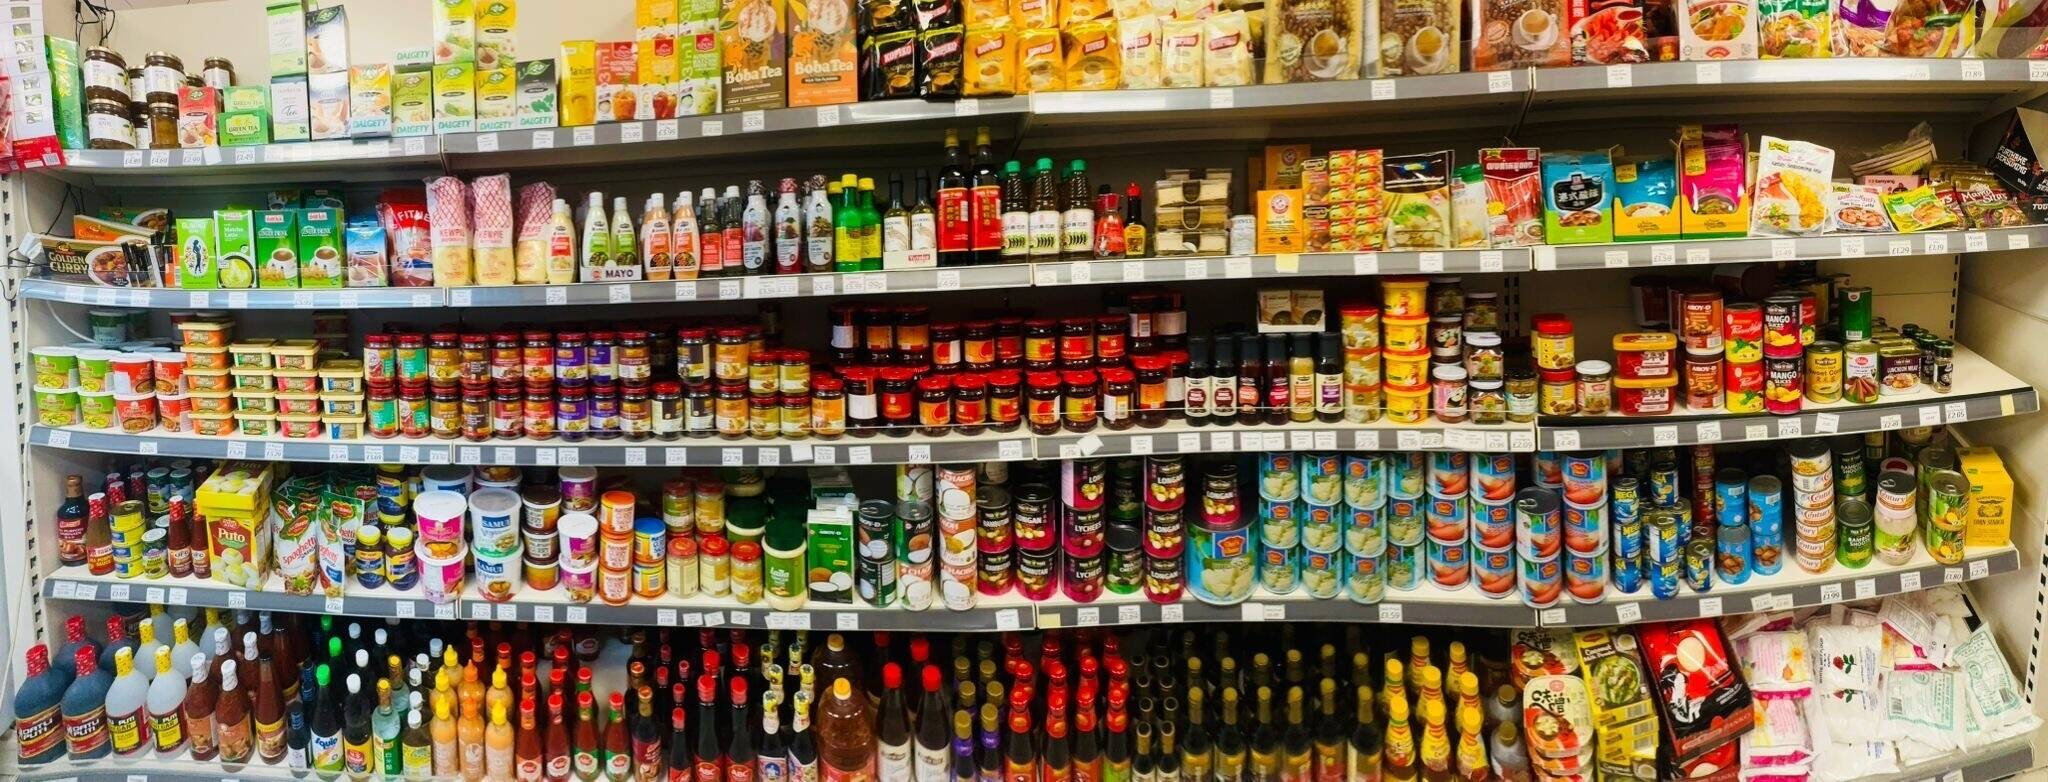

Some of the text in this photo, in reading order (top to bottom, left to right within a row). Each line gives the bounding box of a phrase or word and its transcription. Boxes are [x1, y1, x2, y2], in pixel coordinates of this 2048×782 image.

[396, 50, 430, 60] DALGETY
[794, 58, 854, 76] Boba Tea
[725, 66, 783, 84] Boba Tea
[353, 118, 388, 128] DALGETY
[438, 119, 471, 129] DALGETY
[480, 121, 513, 131] DALGETY
[520, 116, 554, 126] DALGETY
[397, 124, 430, 134] DALGETY
[1996, 152, 2028, 175] SEASONING
[1891, 247, 1910, 255] £1.29
[49, 251, 86, 265] GOLDEN
[50, 261, 88, 275] CURRY
[605, 269, 634, 279] MAYO
[1765, 315, 1791, 324] MANGO
[1770, 370, 1797, 380] MANGO
[1157, 473, 1184, 485] LONGAN
[1614, 489, 1637, 500] MEGA
[1879, 490, 1907, 503] Century
[1804, 508, 1831, 519] Century
[482, 517, 510, 527] SAMUI
[1074, 521, 1102, 533] LYCHEES
[1153, 523, 1181, 534] LONGAN
[218, 527, 246, 542] Puto
[1847, 533, 1872, 543] BAMBOO
[283, 536, 317, 565] Spaghetti
[478, 563, 504, 573] SAMUI
[1151, 570, 1179, 580] LONGAN
[23, 727, 49, 741] PUTI
[73, 727, 96, 737] PUTI
